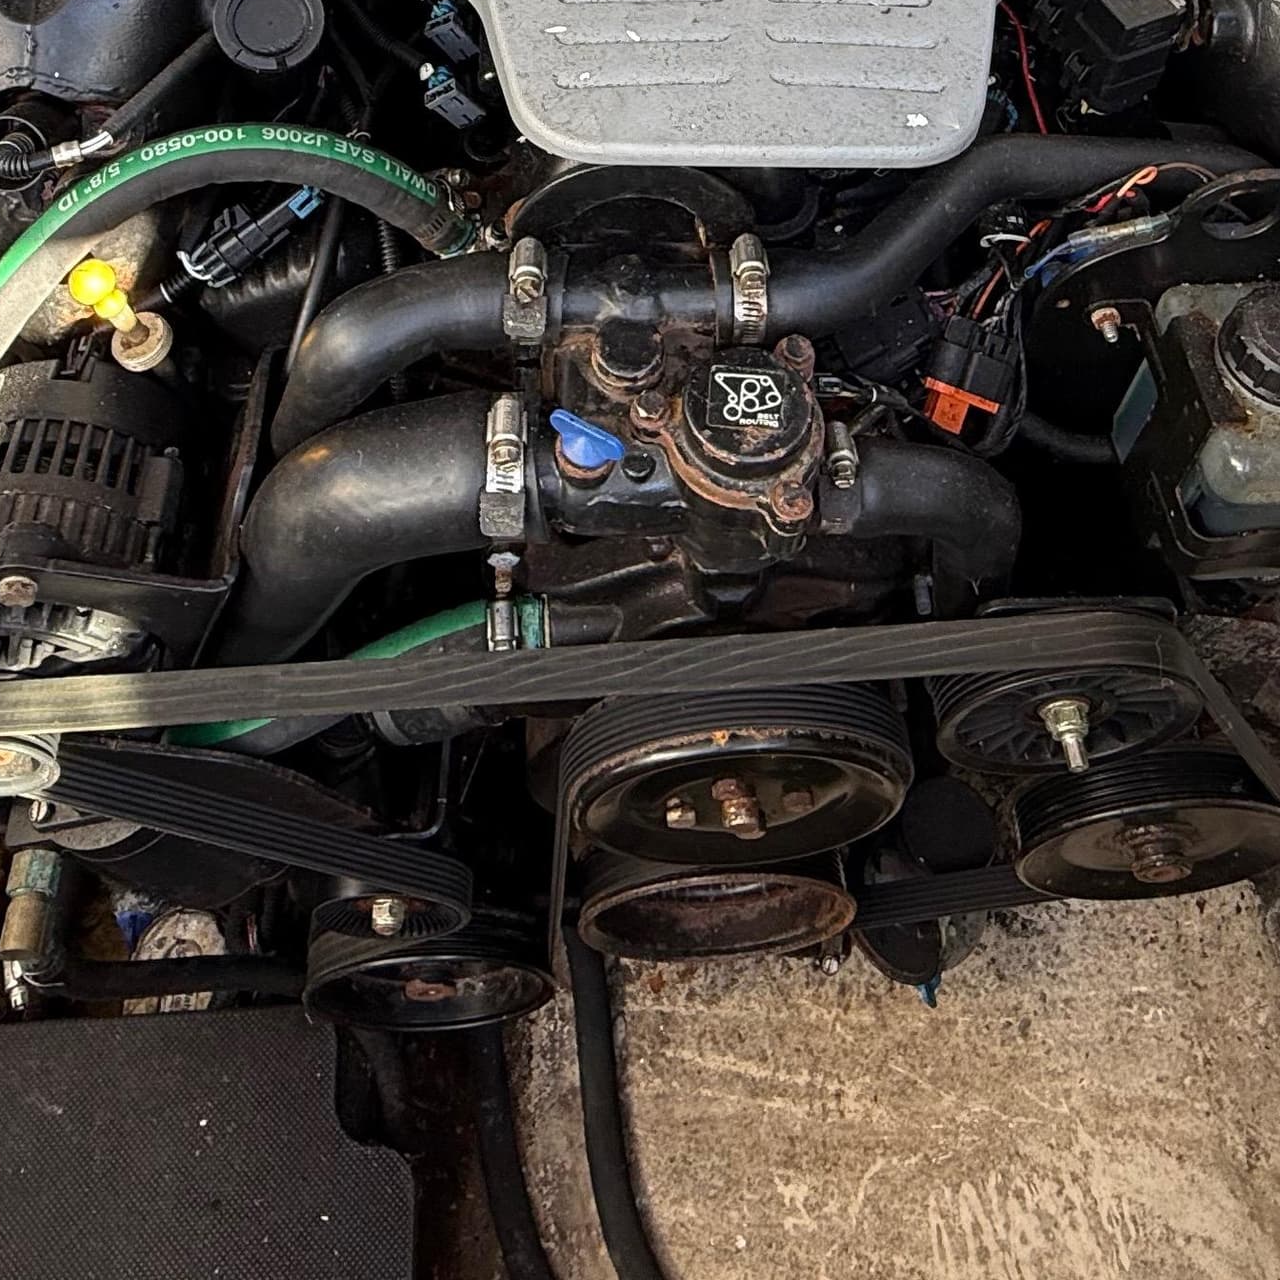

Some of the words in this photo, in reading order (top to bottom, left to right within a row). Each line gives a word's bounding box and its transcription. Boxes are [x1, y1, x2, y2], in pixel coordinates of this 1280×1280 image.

[140, 127, 248, 162] 100-0580
[261, 126, 329, 148] J2006
[333, 137, 376, 164] SAE
[83, 161, 121, 196] 5/8"
[57, 189, 79, 212] ID
[738, 418, 780, 428] ROUTING
[756, 412, 780, 421] BELT
